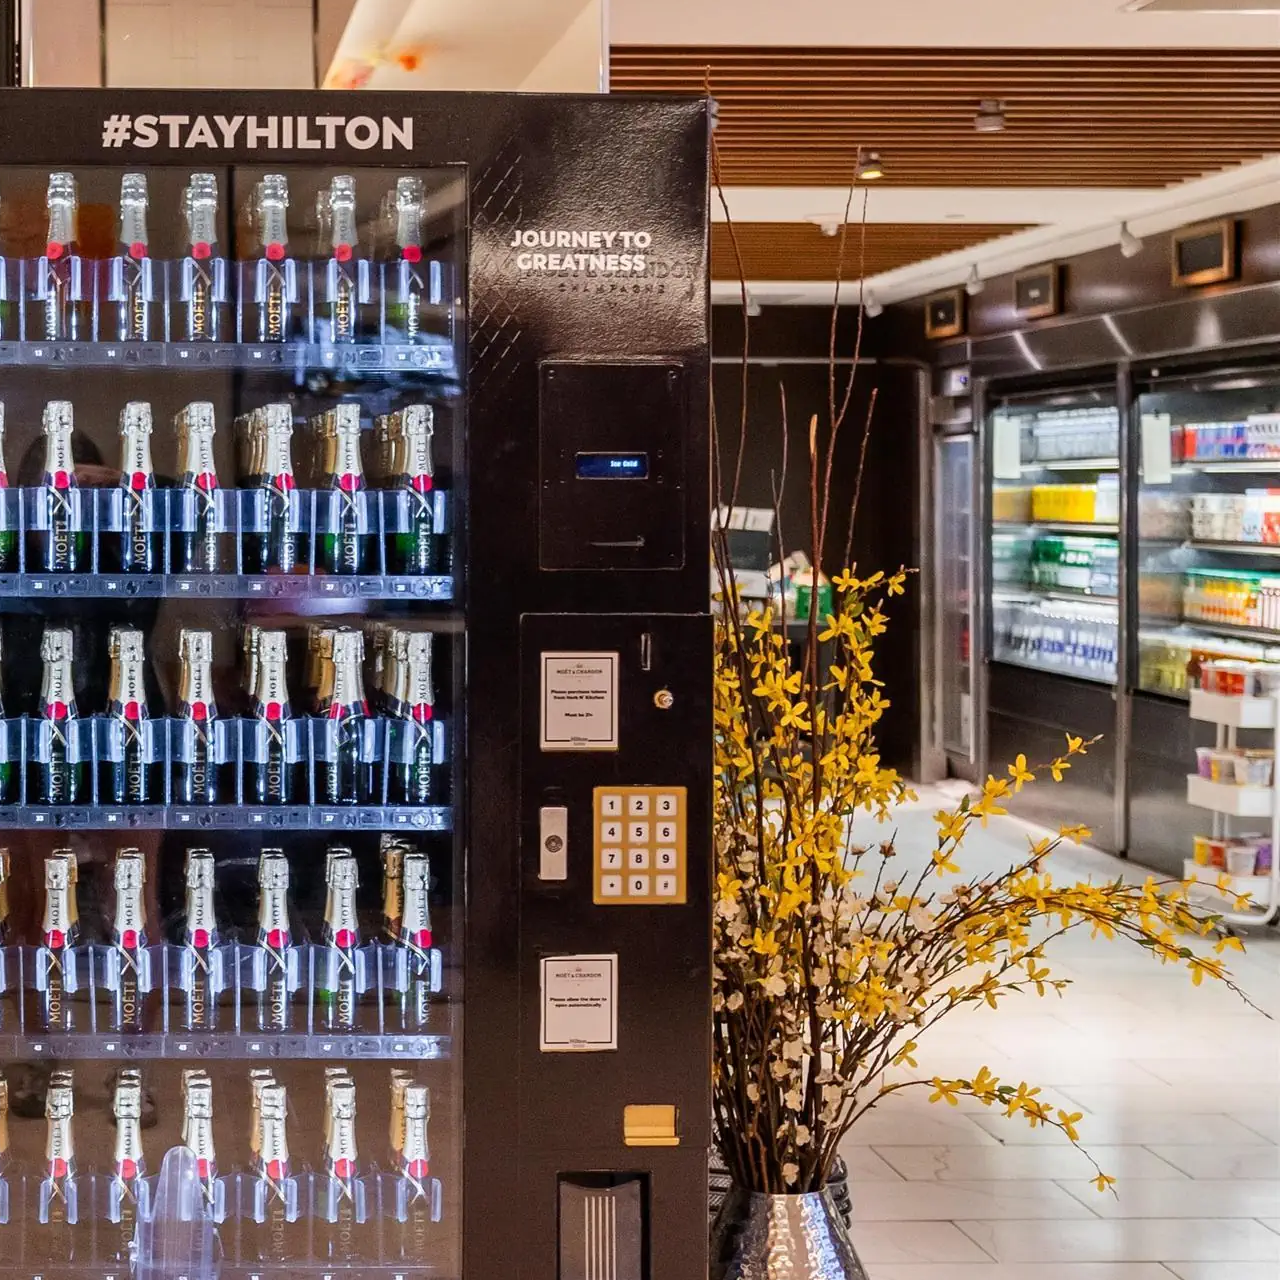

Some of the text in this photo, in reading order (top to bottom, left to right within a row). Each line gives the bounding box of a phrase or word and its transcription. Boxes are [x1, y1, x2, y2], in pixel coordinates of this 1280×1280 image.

[102, 114, 414, 150] #STAYHILTON
[510, 230, 652, 249] JOURNEY TO
[516, 253, 646, 271] GREATNESS
[608, 800, 670, 811] 1 2 3
[608, 827, 670, 837] 4 5 6
[608, 854, 670, 864] 7 8 9
[635, 880, 642, 890] 0
